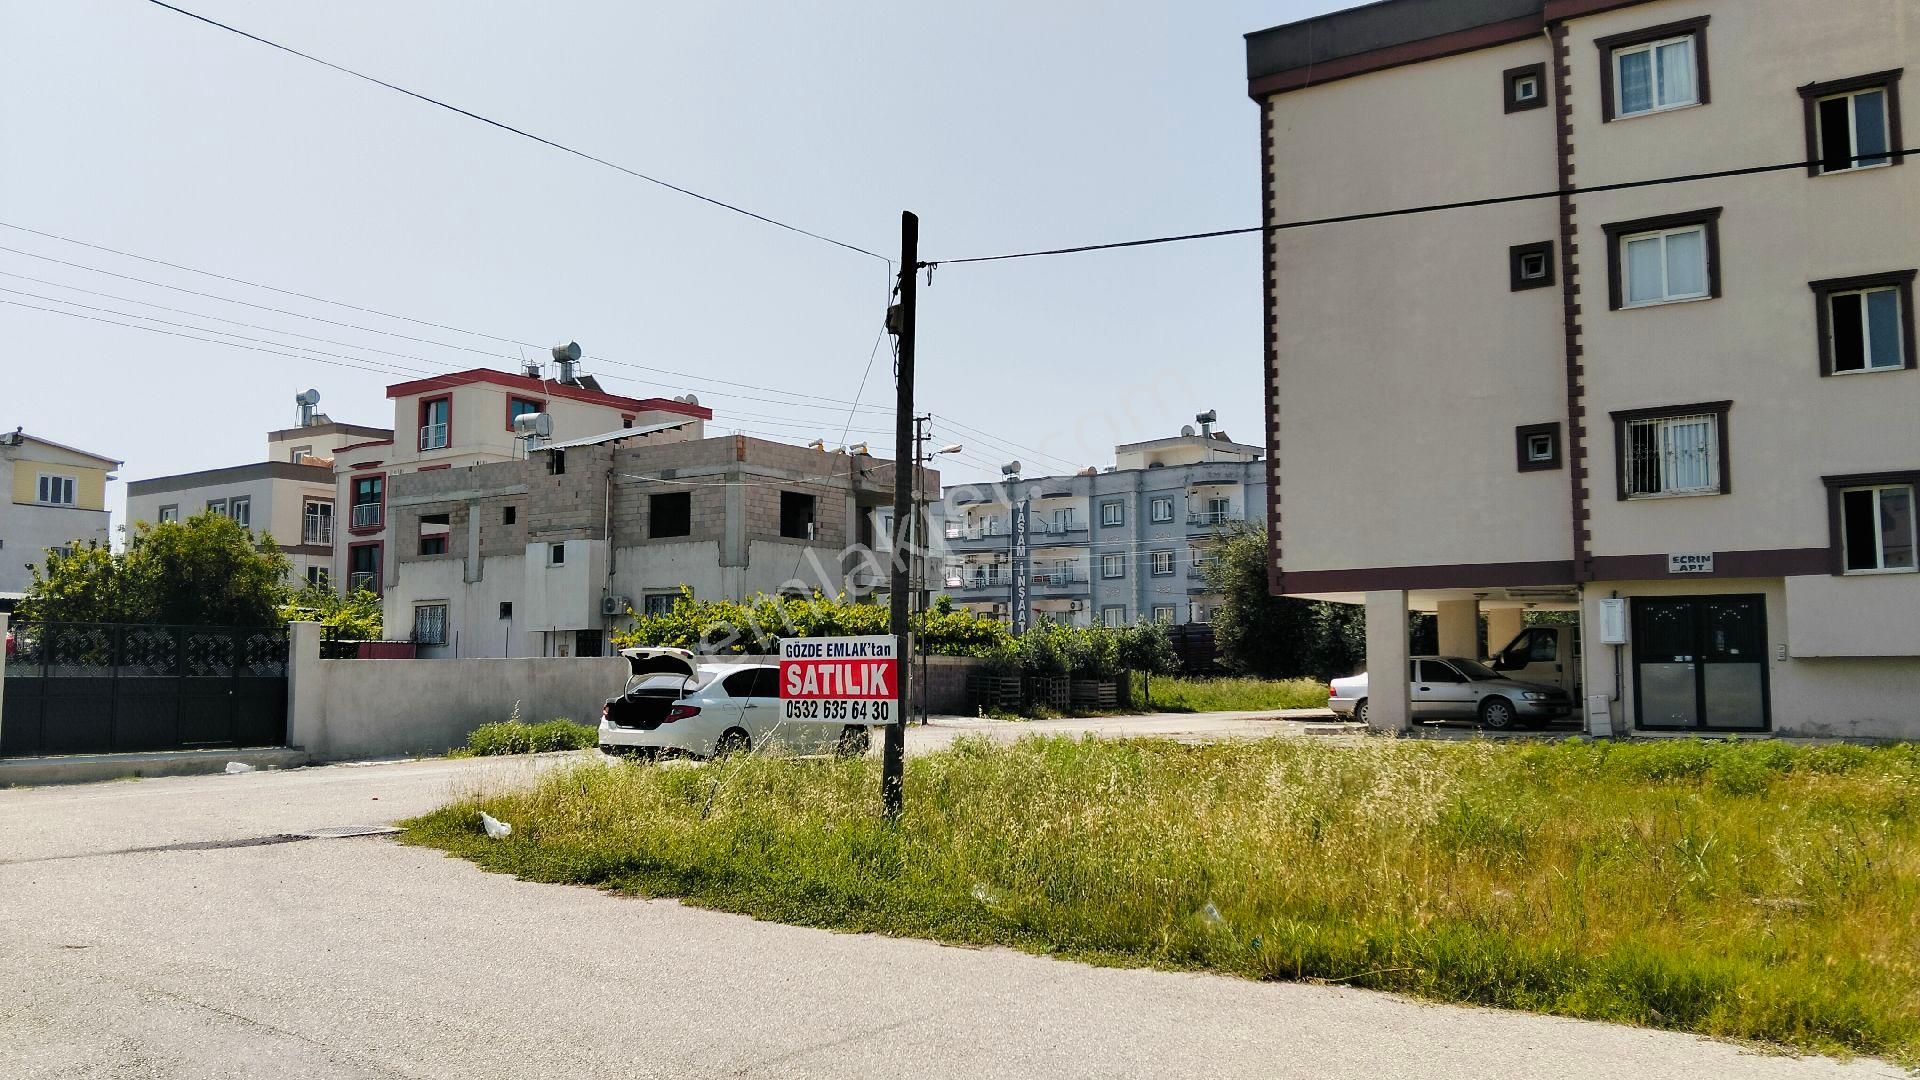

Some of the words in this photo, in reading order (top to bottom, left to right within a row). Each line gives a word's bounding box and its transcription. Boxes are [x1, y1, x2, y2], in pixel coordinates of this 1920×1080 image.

[1017, 561, 1027, 633] İNŞAAT
[786, 641, 823, 658] GÖZDE
[826, 642, 891, 657] EMLAK'tan
[786, 663, 889, 696] SATILIK
[786, 700, 818, 719] 0532
[823, 700, 847, 719] 635
[851, 701, 867, 720] 64
[871, 701, 889, 721] 30
